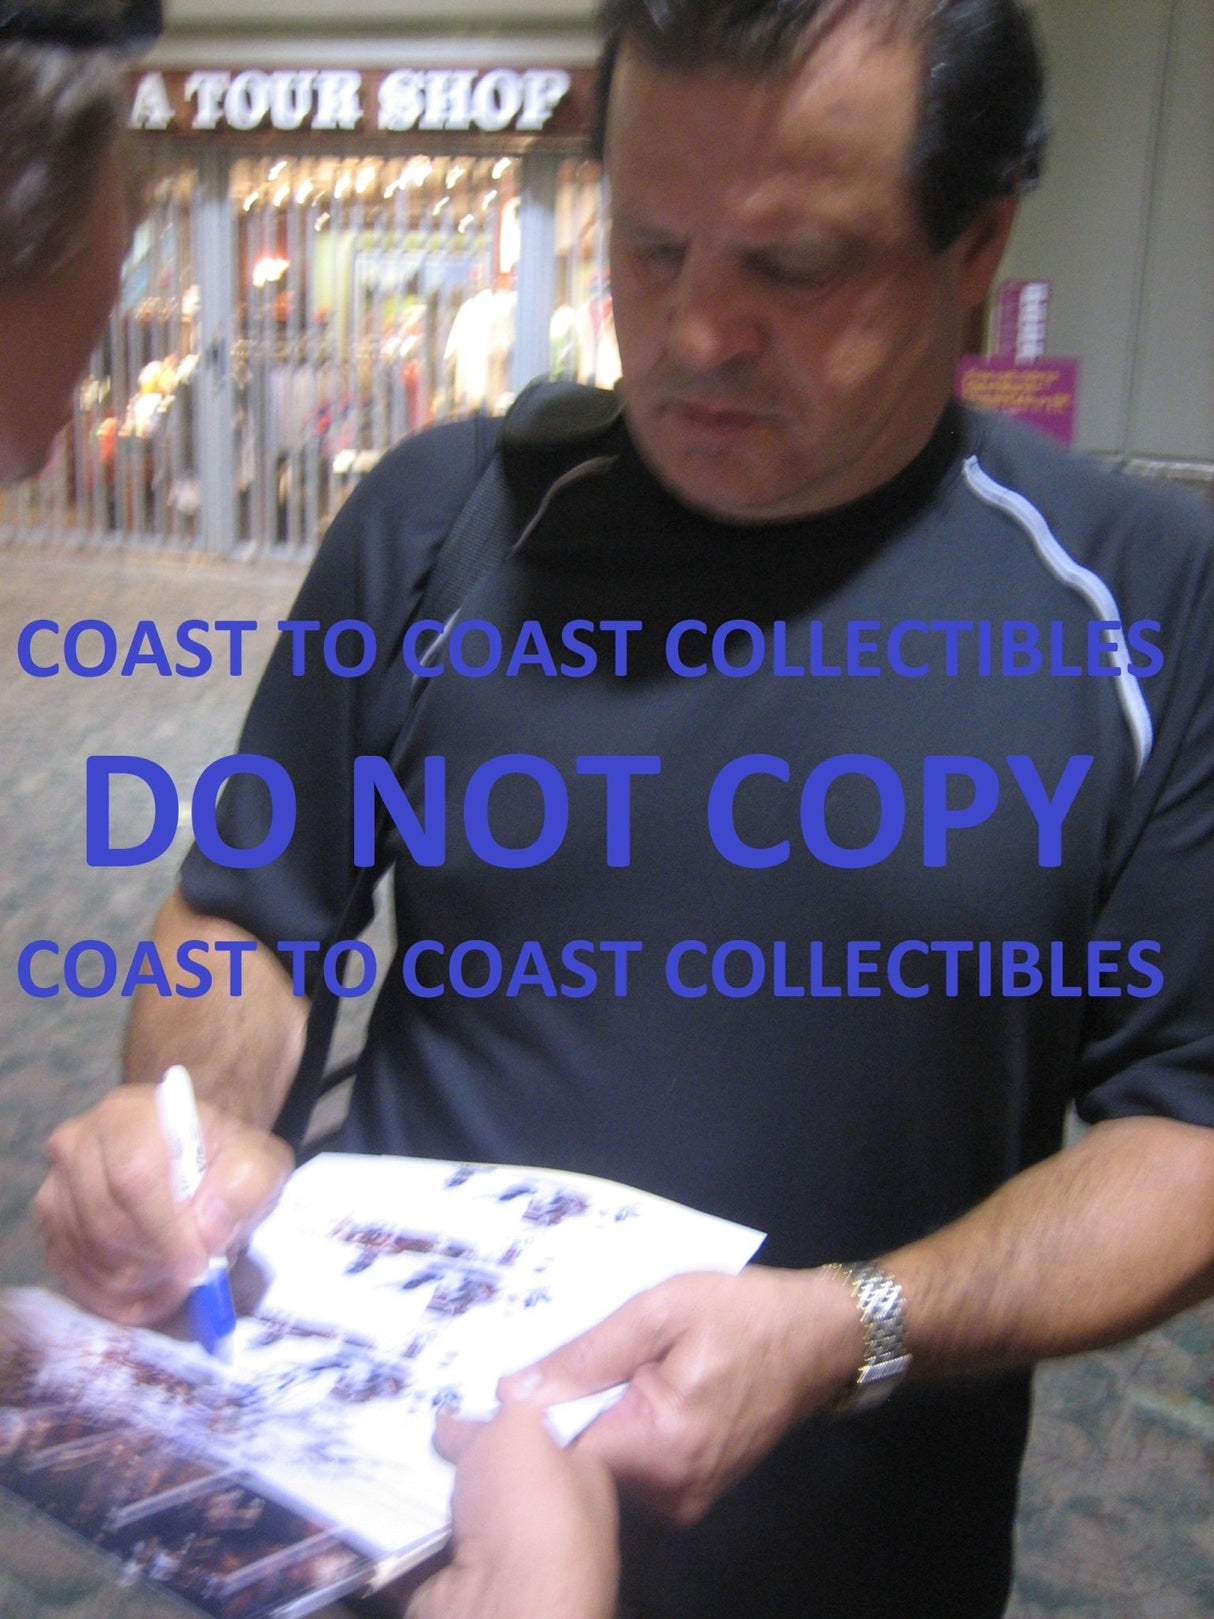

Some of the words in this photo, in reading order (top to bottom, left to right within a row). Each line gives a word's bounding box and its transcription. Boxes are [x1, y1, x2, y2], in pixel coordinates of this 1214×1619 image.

[130, 71, 175, 130] A
[184, 70, 363, 131] TOUR
[377, 68, 571, 131] SHOP
